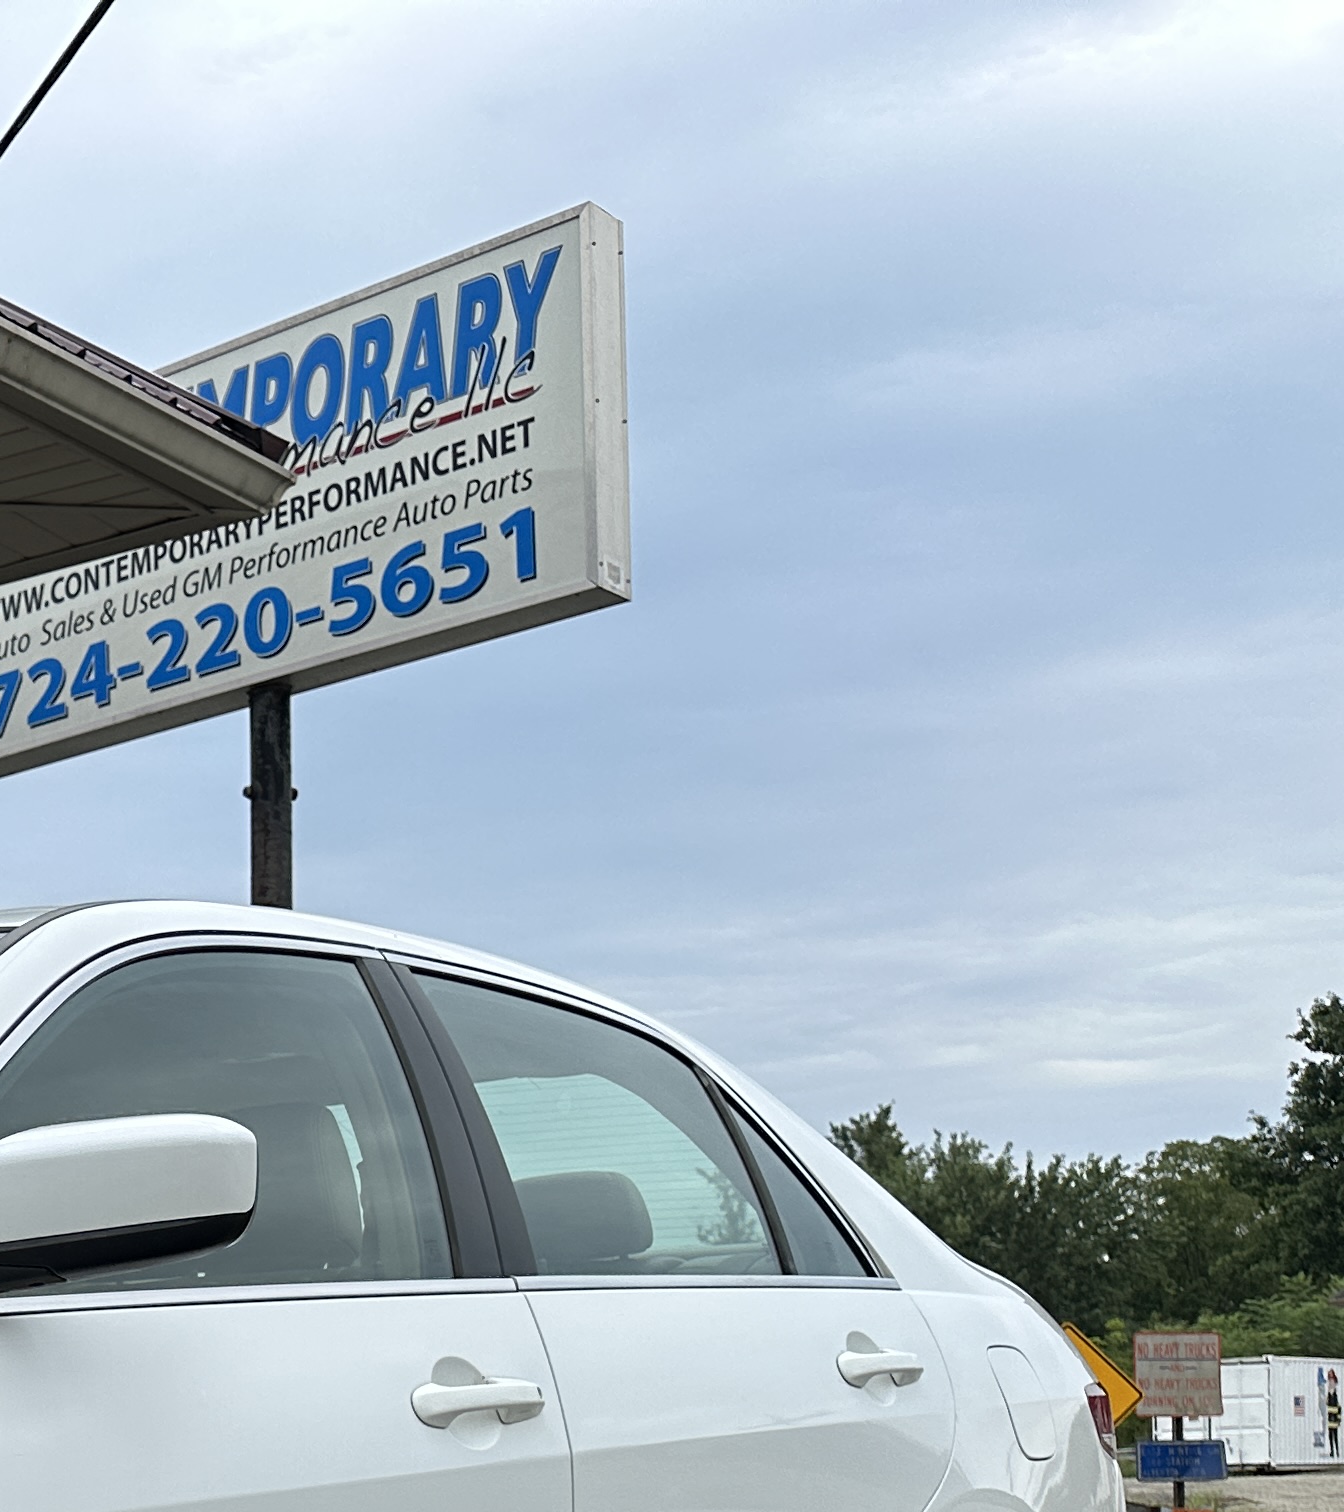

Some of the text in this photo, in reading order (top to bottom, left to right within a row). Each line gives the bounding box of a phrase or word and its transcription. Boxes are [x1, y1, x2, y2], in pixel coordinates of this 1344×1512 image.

[40, 606, 95, 646] Sales
[100, 599, 117, 627] &
[123, 575, 177, 620] Used
[182, 562, 223, 599] GM
[229, 517, 387, 586] Performance
[392, 494, 457, 533] Auto
[464, 466, 534, 510] Parts
[1137, 1341, 1217, 1359] NO HEAVY TRUCKS
[1154, 1377, 1180, 1390] HEAVY
[1186, 1377, 1218, 1390] TRUCKS
